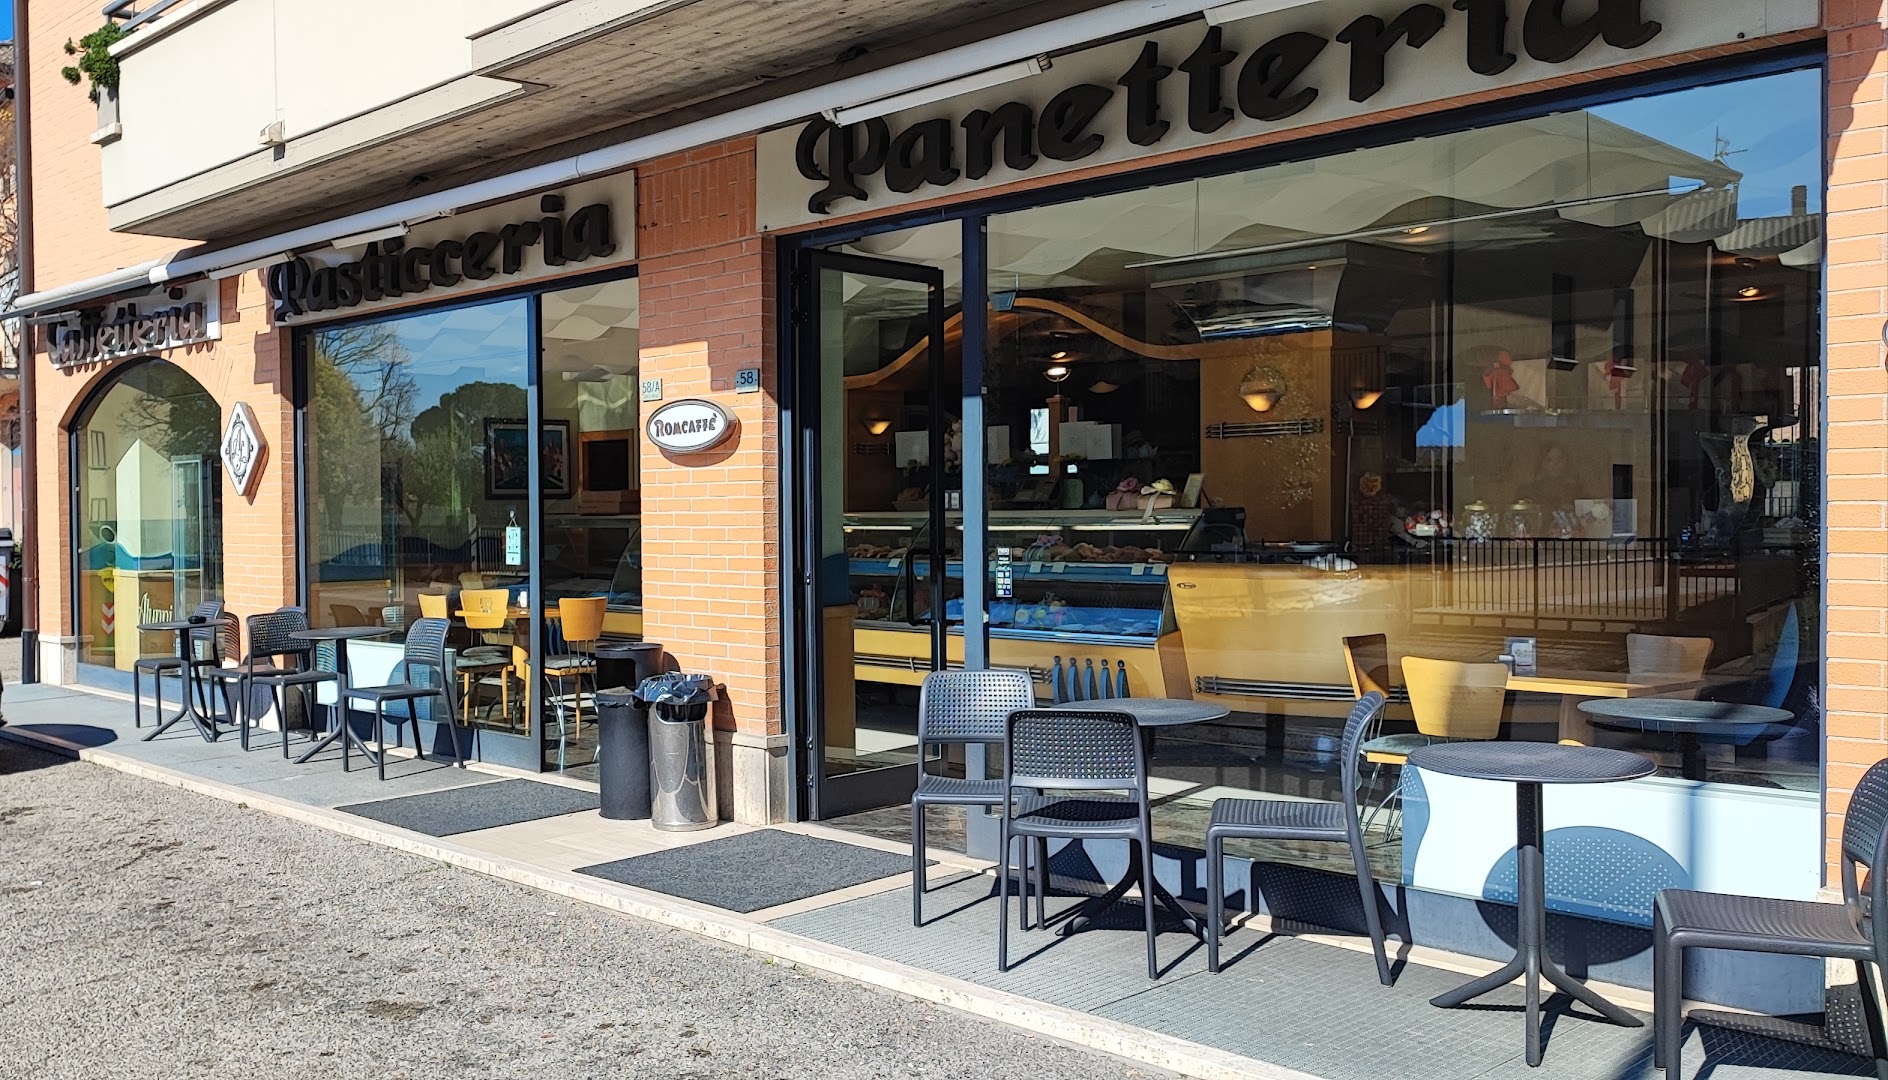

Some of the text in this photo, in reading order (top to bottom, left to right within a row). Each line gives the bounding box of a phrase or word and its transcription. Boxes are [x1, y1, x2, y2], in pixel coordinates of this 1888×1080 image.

[796, 0, 1662, 215] Panetteria
[268, 194, 616, 322] Pasticceria
[46, 287, 206, 365] Caffetteria
[642, 381, 660, 394] 58/A
[740, 371, 754, 385] 58
